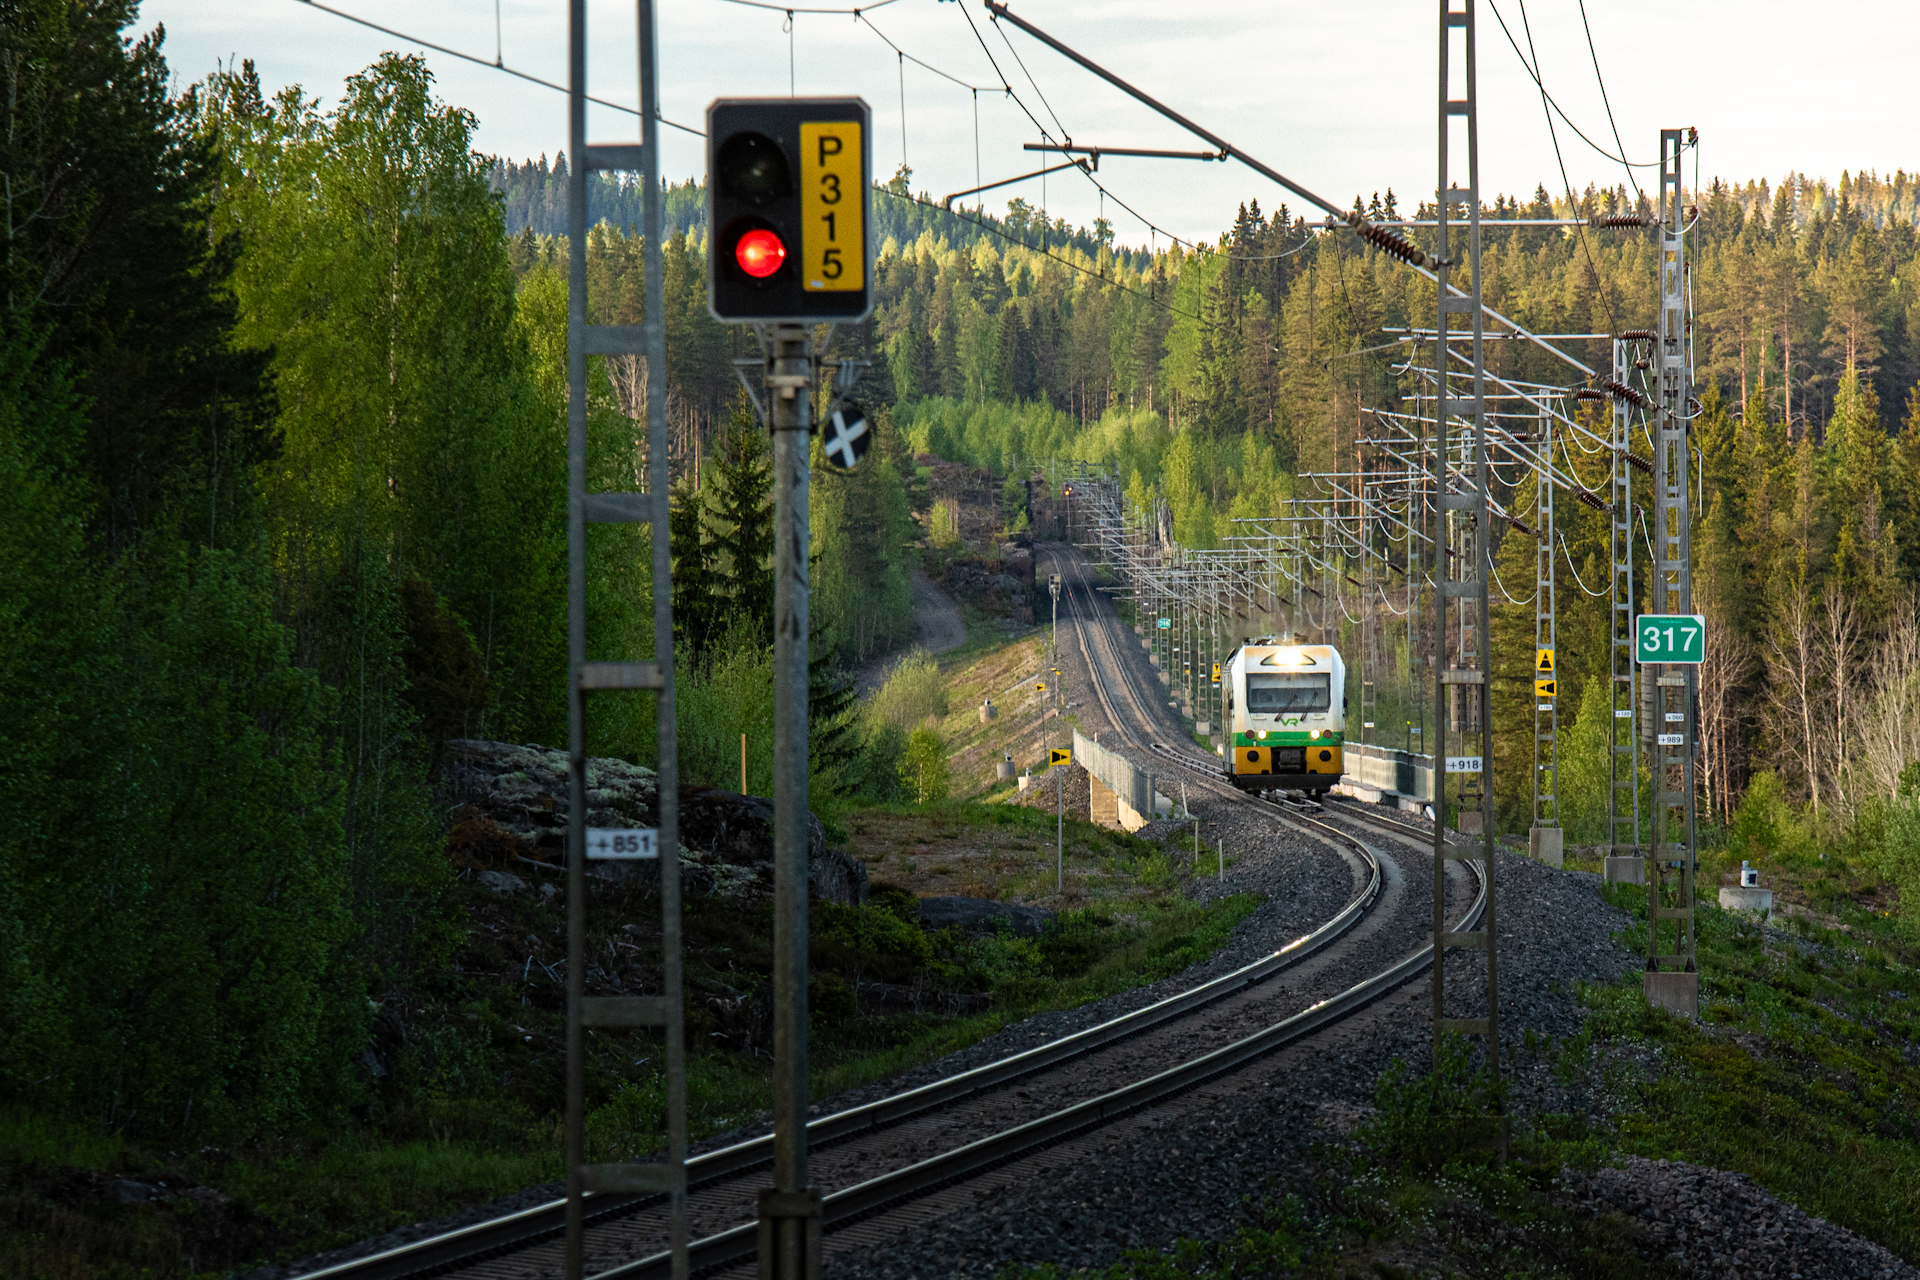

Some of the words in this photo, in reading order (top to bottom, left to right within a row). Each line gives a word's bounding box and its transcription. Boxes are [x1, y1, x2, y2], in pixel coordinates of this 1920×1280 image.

[818, 135, 843, 279] P315
[1643, 626, 1698, 652] 317
[1280, 718, 1298, 726] VR
[1450, 760, 1479, 770] +918
[597, 835, 650, 854] +851
